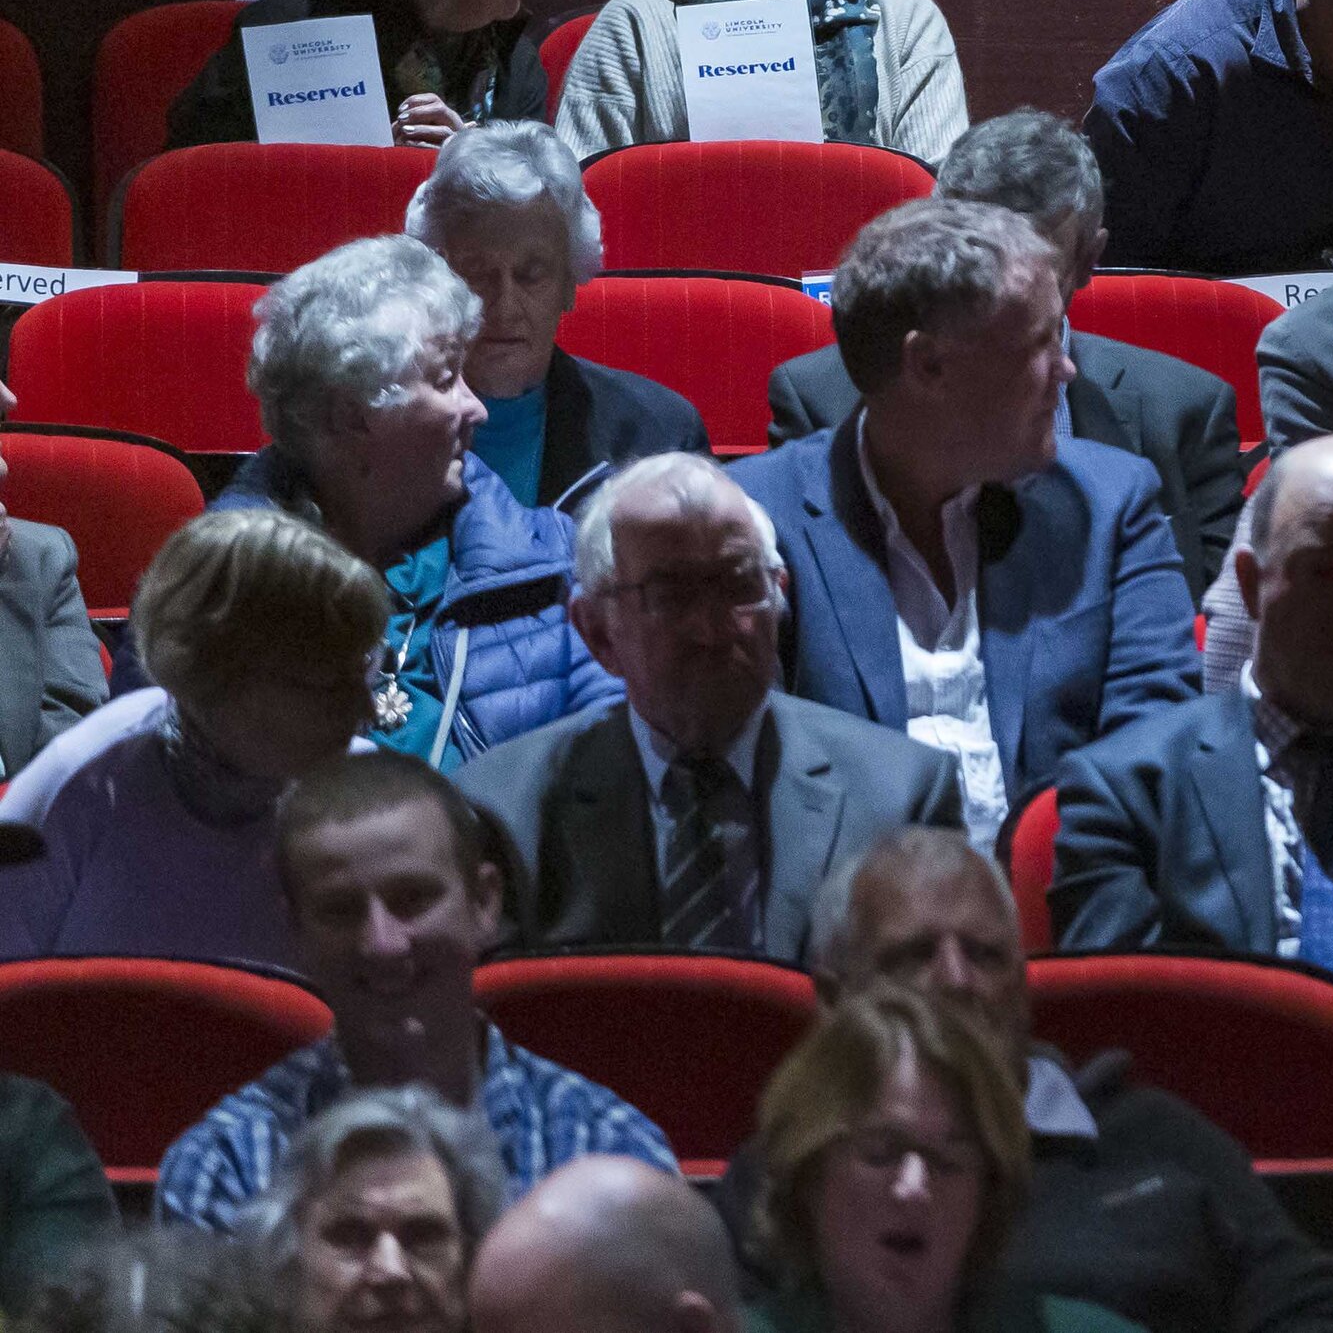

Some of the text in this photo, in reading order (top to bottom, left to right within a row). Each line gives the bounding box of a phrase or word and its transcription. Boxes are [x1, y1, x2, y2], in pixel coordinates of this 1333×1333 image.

[724, 19, 764, 27] LINCOLN
[725, 23, 782, 33] UNIVERSITY
[292, 40, 332, 50] LINCOLN
[293, 44, 351, 56] UNIVERSITY
[698, 57, 796, 78] Reserved
[268, 81, 366, 107] Reserved
[0, 272, 65, 296] rved
